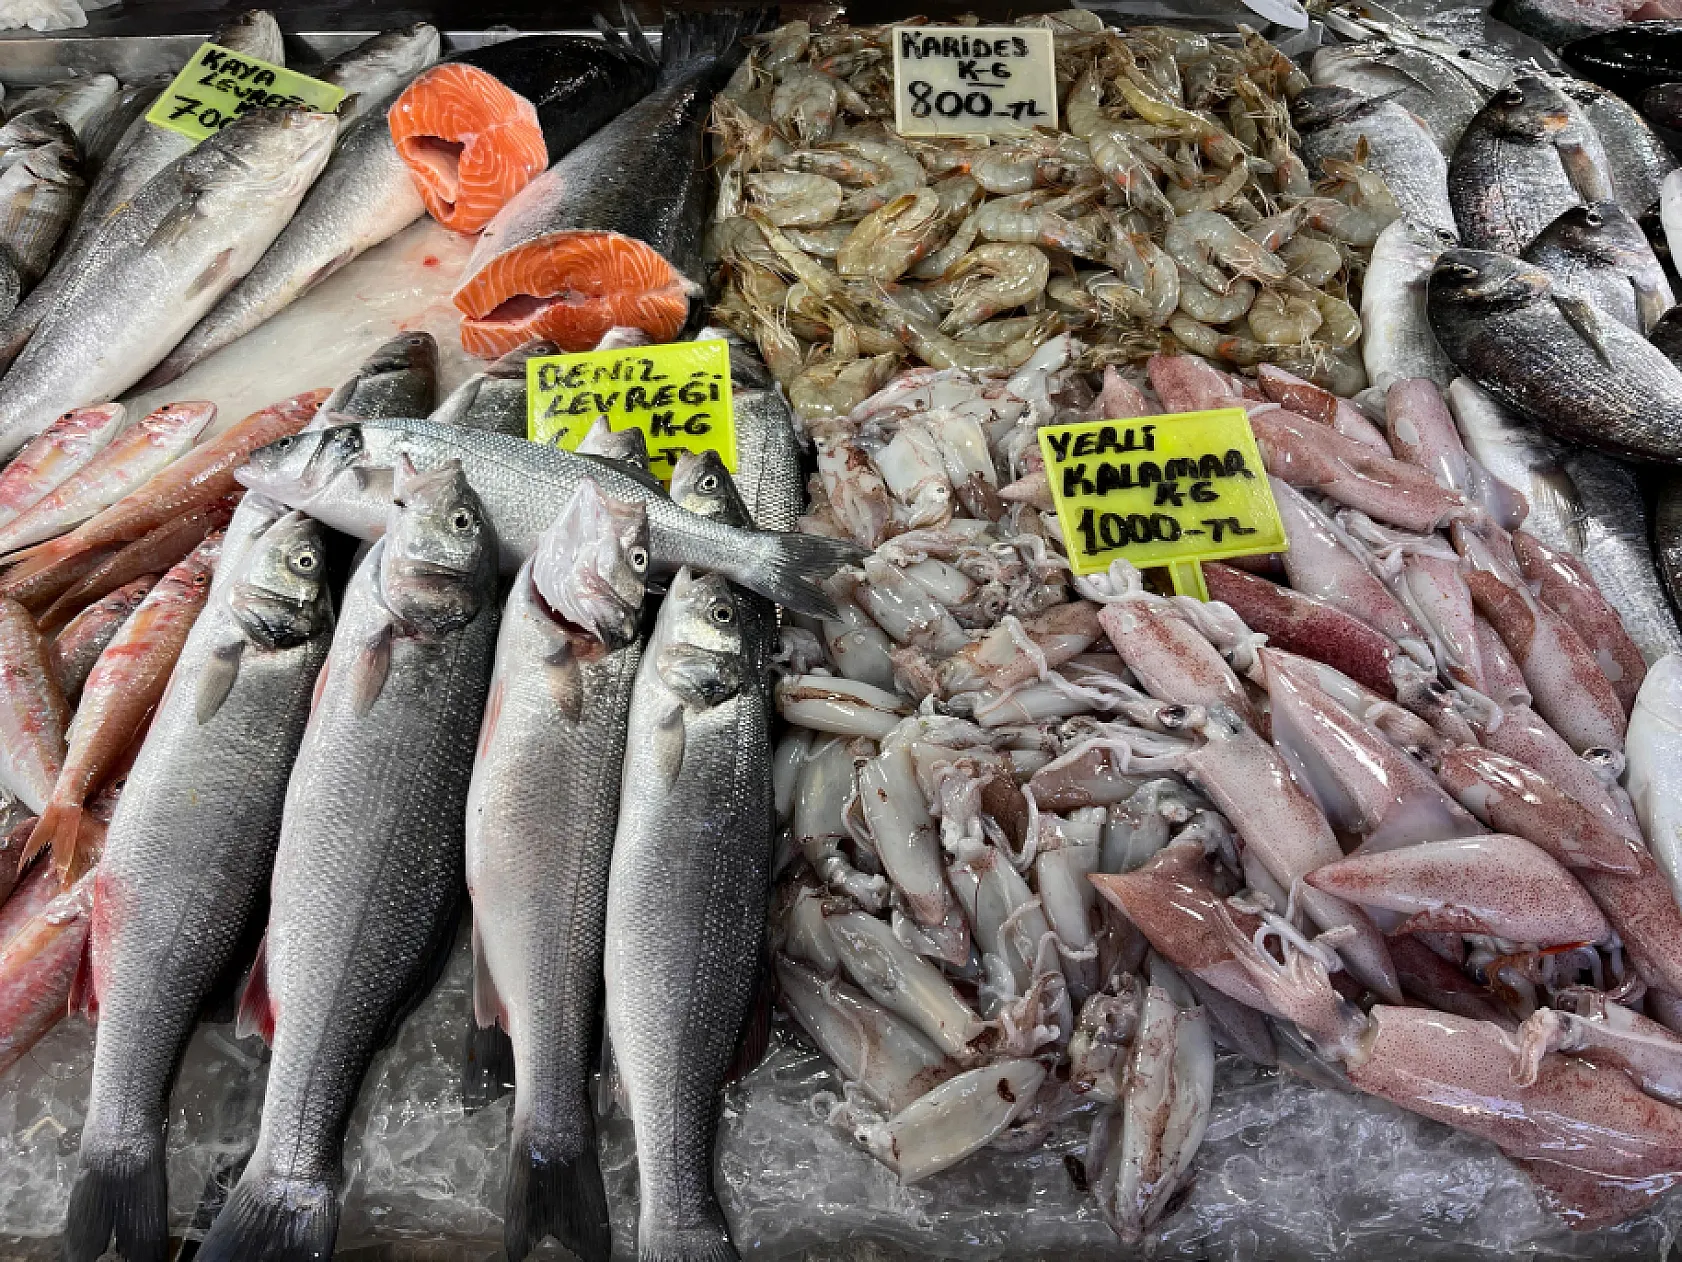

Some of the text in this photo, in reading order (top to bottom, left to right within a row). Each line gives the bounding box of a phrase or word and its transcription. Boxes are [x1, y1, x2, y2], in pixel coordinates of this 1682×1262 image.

[200, 49, 276, 87] KAYA
[1047, 424, 1157, 462] YERLİ
[1063, 449, 1256, 497] KALAMAR
